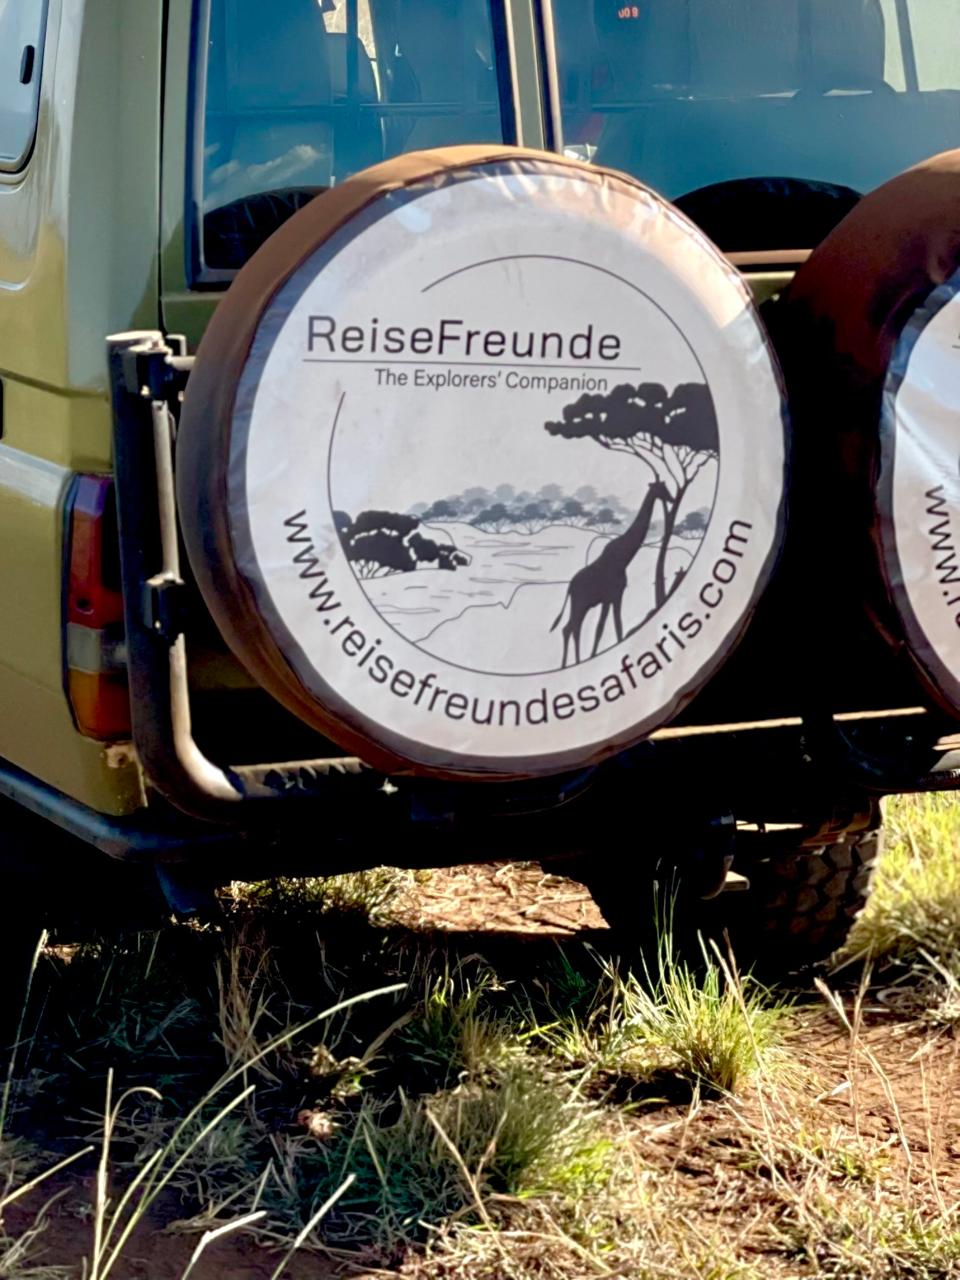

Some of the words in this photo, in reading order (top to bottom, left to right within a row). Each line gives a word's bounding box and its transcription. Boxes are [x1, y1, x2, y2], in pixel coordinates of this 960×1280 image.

[307, 315, 622, 360] ReiseFreunde
[374, 368, 408, 386] The
[414, 369, 502, 391] Explorers'
[505, 371, 608, 394] Companion
[283, 510, 753, 727] www.reisefreundesafaris.com
